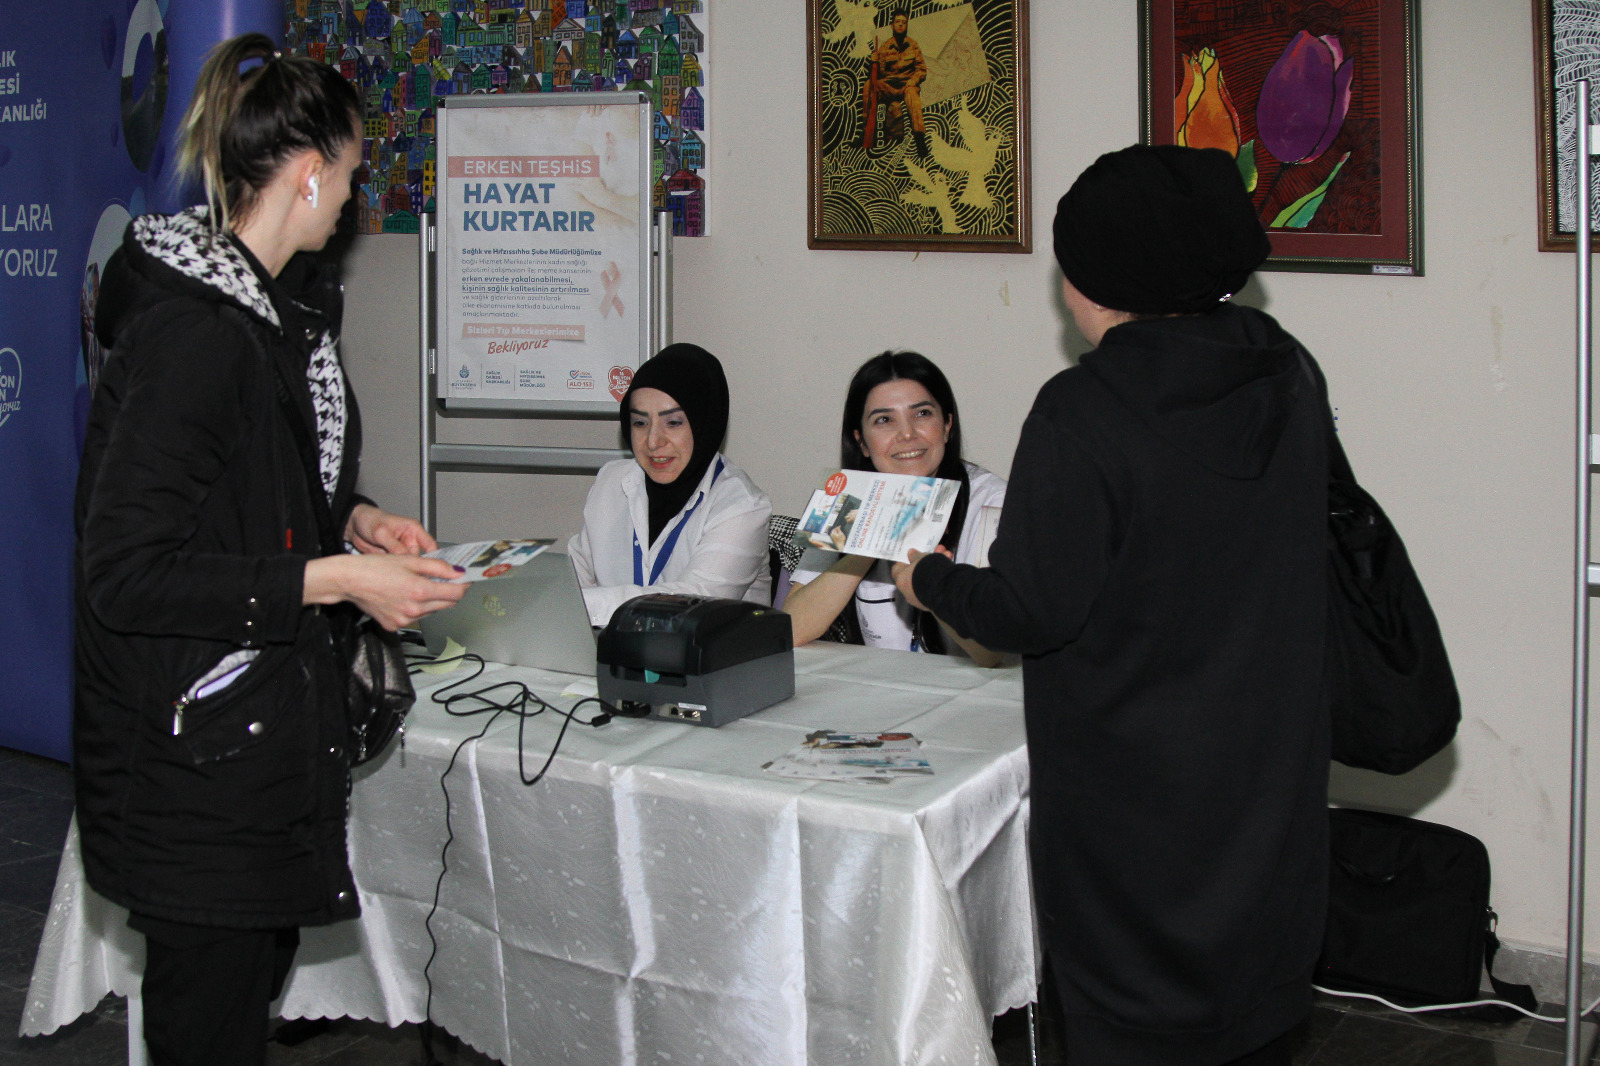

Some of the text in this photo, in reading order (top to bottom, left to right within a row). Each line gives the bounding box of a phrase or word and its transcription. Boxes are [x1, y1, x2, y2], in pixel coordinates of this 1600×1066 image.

[0, 50, 16, 67] IK
[0, 97, 47, 123] ANLIĞI
[464, 159, 592, 177] ERKEN TEŞHİS
[464, 183, 556, 204] HAYAT
[1, 203, 53, 232] LARA
[463, 210, 595, 232] KURTARIR
[461, 248, 483, 256] Sağlık
[531, 248, 548, 256] Şube
[549, 248, 602, 257] Müdürlüğümüze
[461, 258, 478, 266] bağlı
[510, 275, 573, 284] yakalanabilmesi,
[462, 284, 589, 293] kişinin sağlık kalitesinin artırılması
[467, 325, 580, 337] Sizleri Tıp Merkezlerimize
[487, 339, 550, 355] Bekliyoruz
[0, 374, 15, 389] ON
